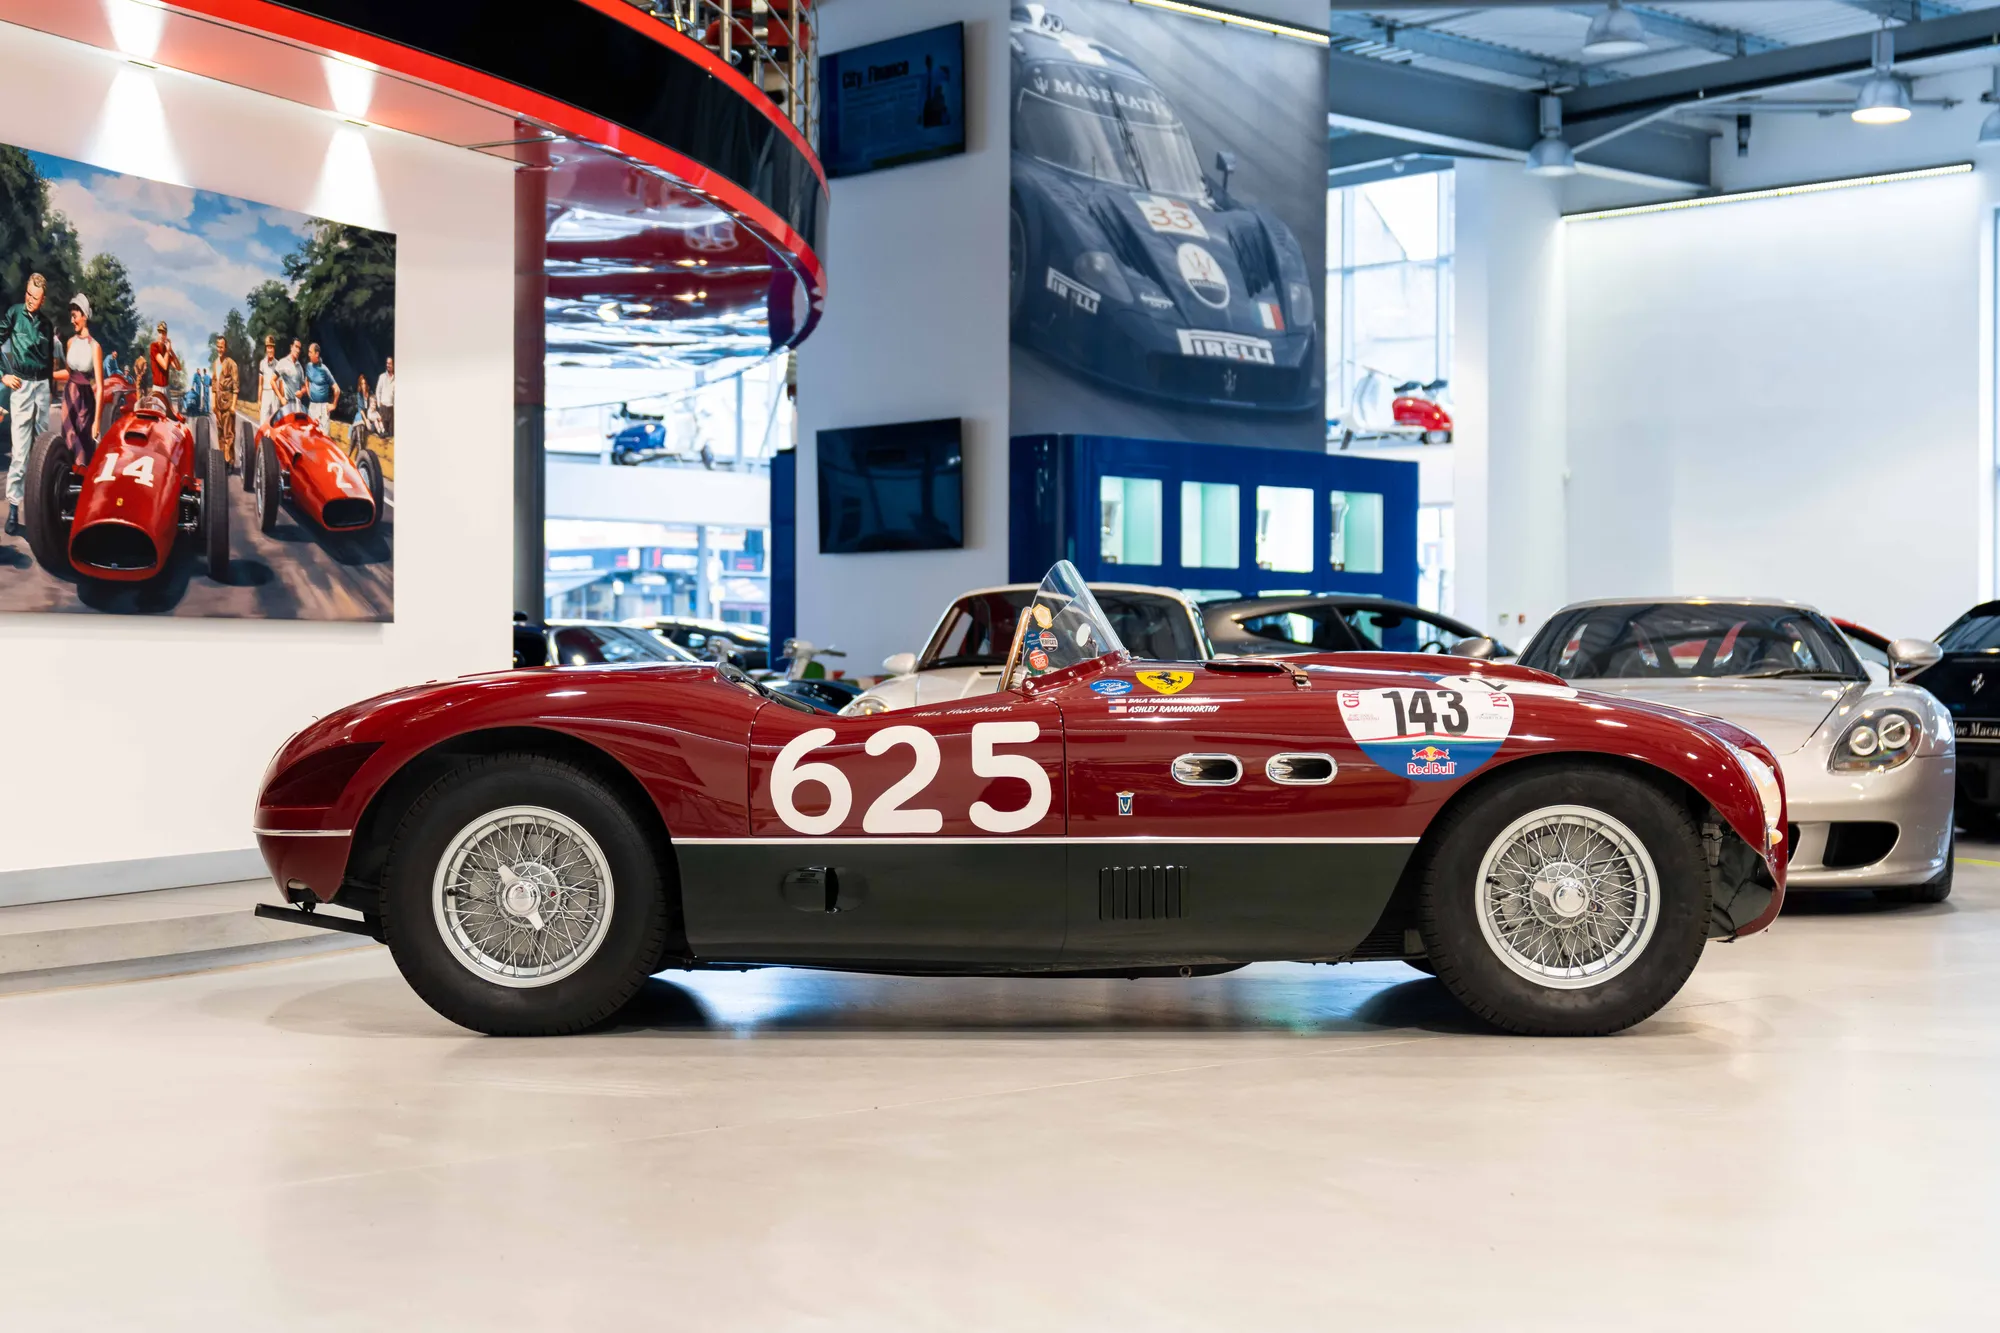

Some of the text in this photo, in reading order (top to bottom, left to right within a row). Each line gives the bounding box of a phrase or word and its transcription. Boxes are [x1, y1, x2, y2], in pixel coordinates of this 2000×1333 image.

[1053, 78, 1162, 116] MASERATI
[1149, 206, 1193, 230] 33
[1176, 328, 1275, 365] PIRELLI
[93, 453, 155, 487] 14
[946, 706, 1013, 715] Hawthorn
[1158, 705, 1220, 713] RAMAMOORTHY
[1382, 690, 1469, 736] 143
[770, 721, 1052, 835] 625
[1407, 762, 1455, 774] Red Bull
